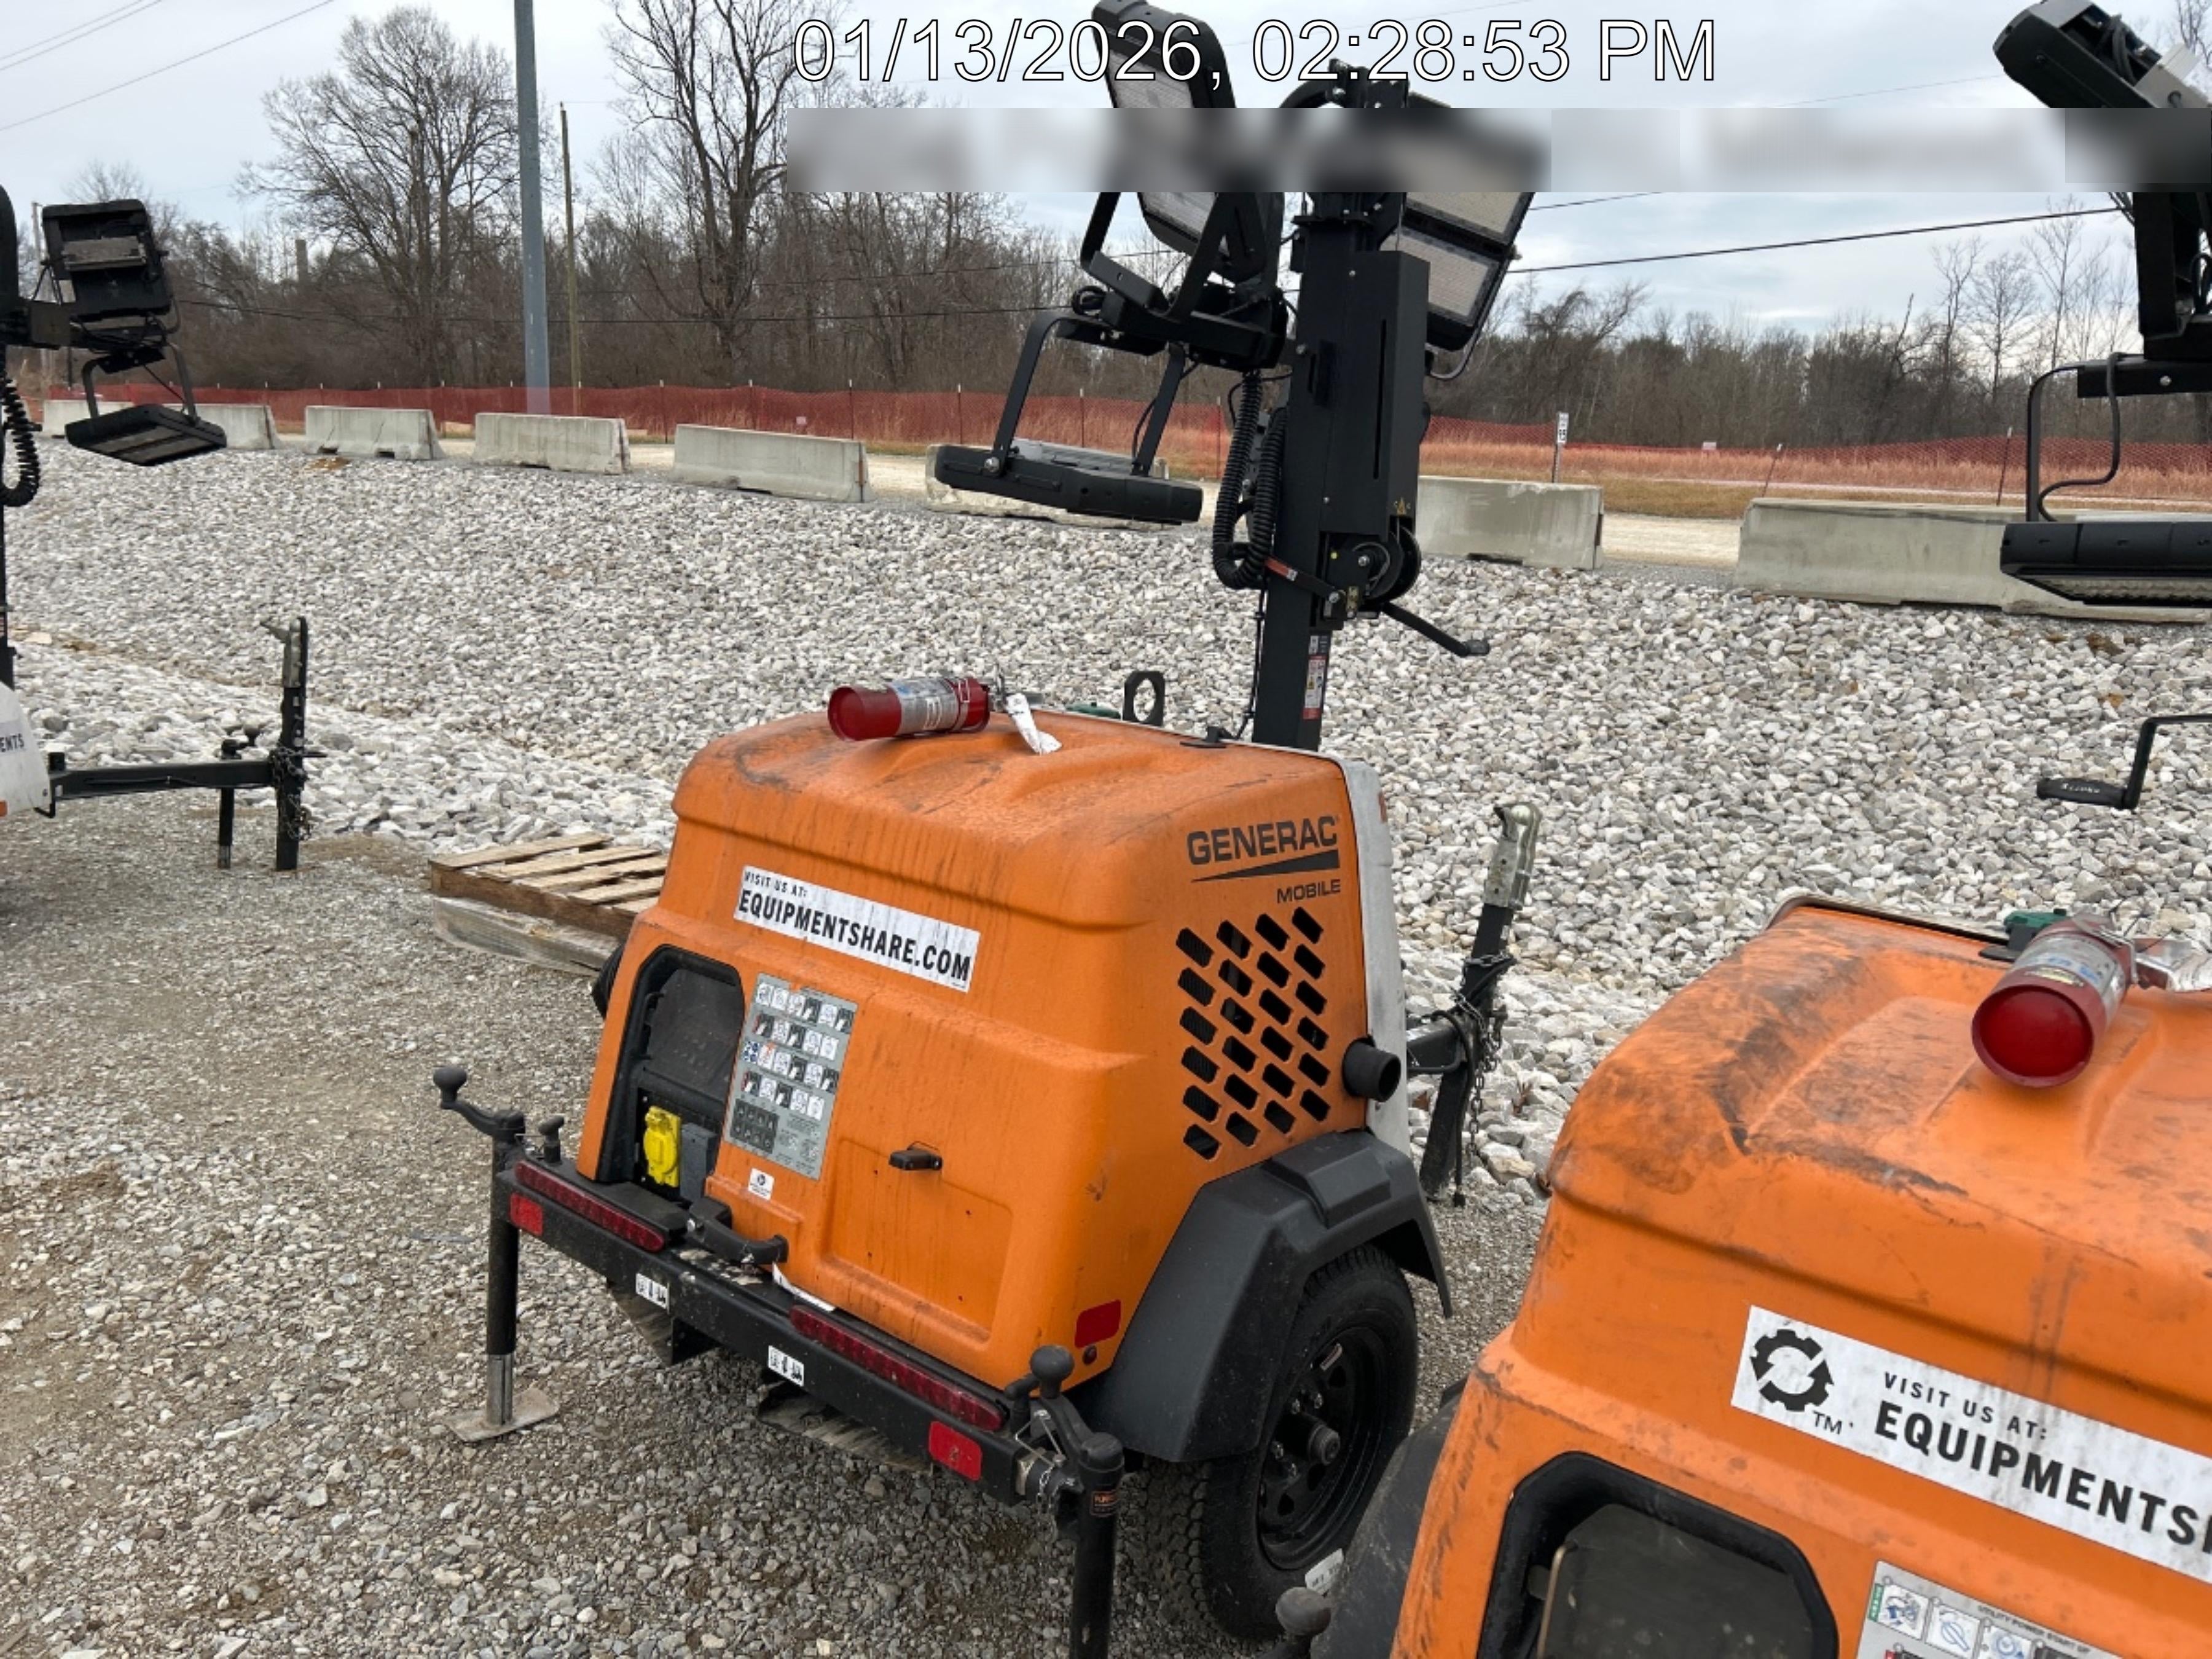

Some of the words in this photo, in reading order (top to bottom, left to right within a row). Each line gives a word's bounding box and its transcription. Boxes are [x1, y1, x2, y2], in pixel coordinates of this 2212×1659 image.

[1187, 816, 1338, 865] GENERAC
[745, 871, 771, 888] VISIT
[774, 879, 788, 893] US
[791, 884, 808, 898] AT:
[1277, 879, 1341, 903] MOBILE
[738, 888, 971, 981] EQUIPMENTSHARE.COM
[1813, 1410, 1843, 1435] TM
[1885, 1371, 1950, 1408] VISIT
[1963, 1399, 1994, 1424] US
[2007, 1415, 2047, 1440] AT:
